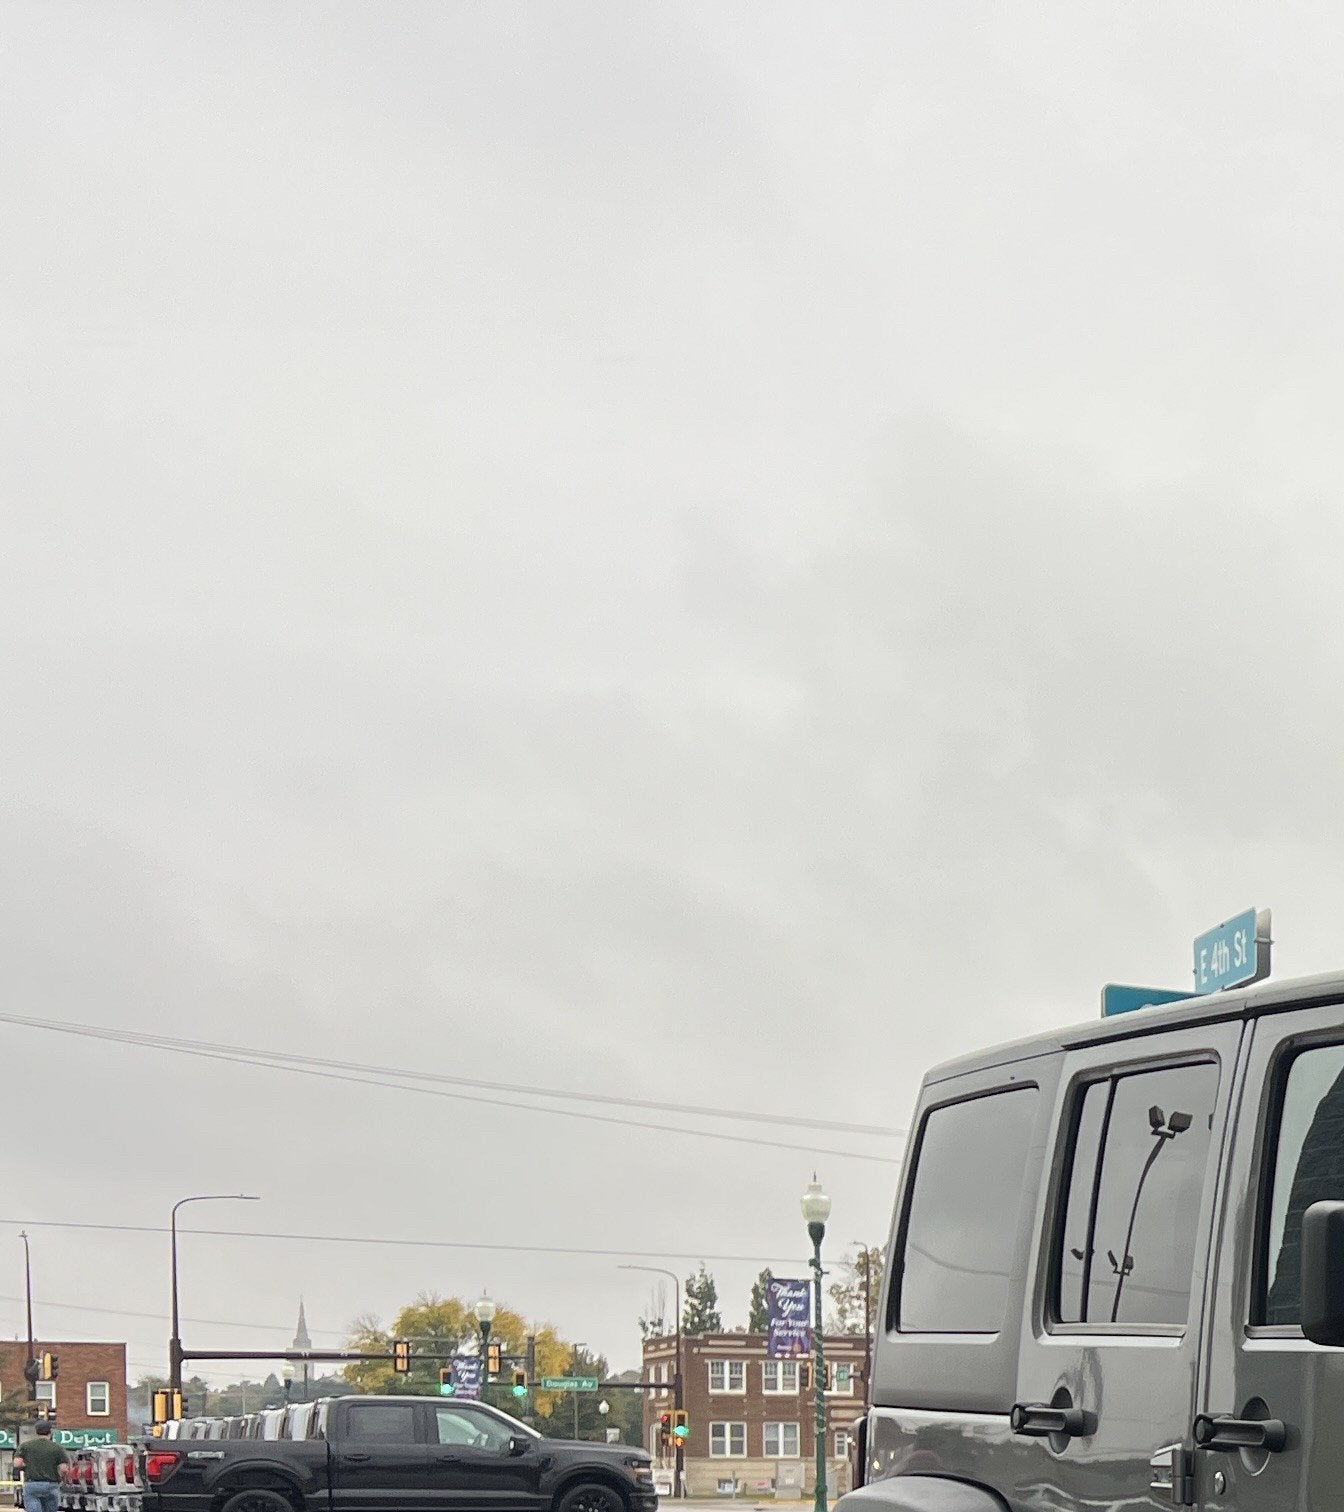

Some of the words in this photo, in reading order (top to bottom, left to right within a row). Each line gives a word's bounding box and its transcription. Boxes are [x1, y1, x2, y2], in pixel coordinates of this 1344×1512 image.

[1200, 949, 1208, 984] E
[1210, 939, 1230, 978] 4th
[1233, 928, 1248, 968] St
[771, 1282, 807, 1299] Thank
[777, 1299, 805, 1318] You
